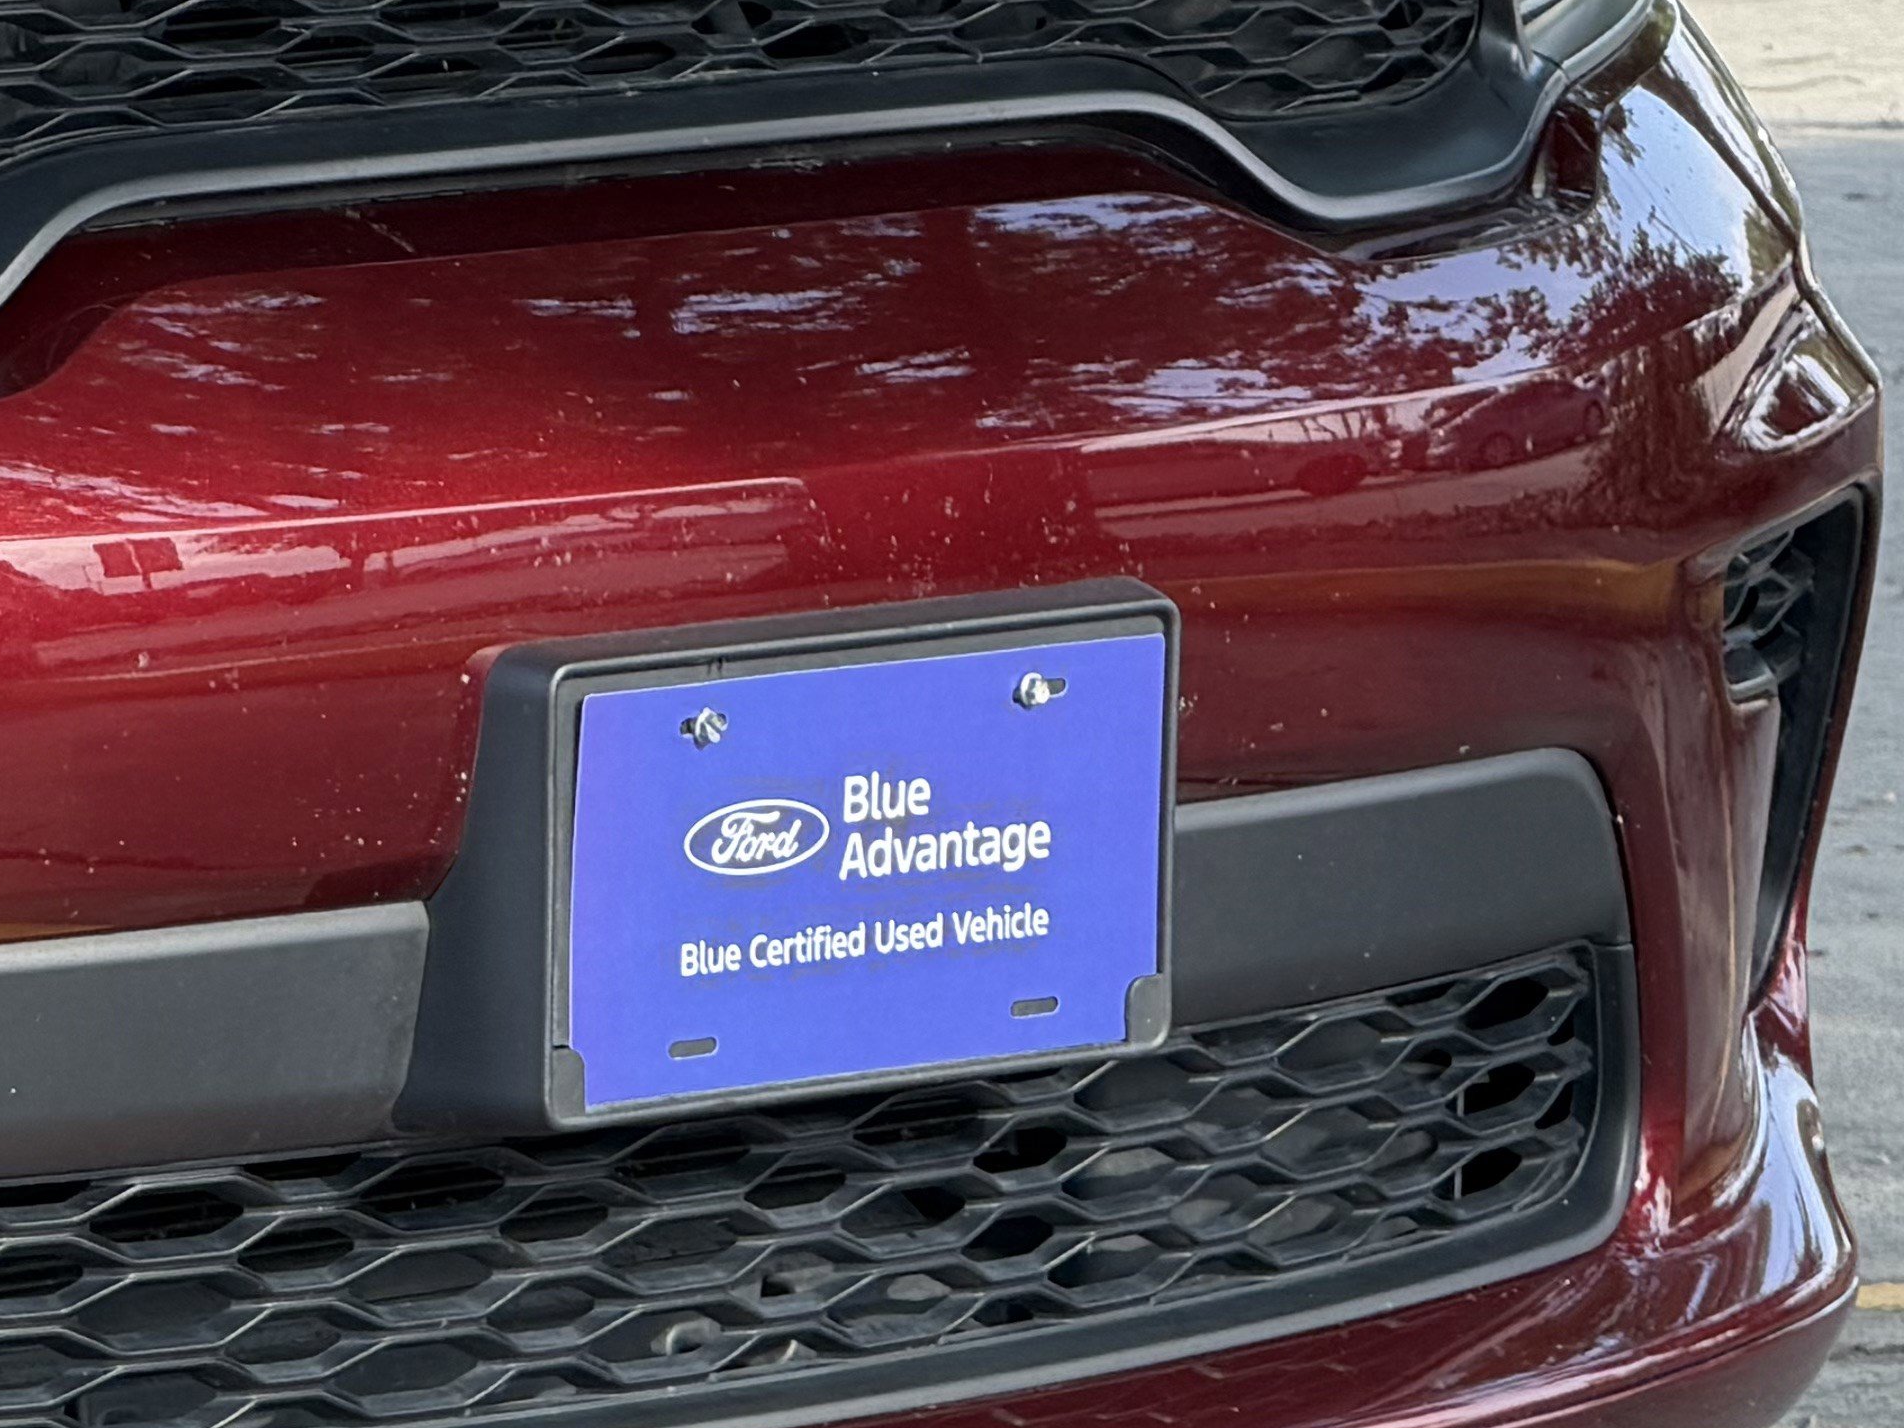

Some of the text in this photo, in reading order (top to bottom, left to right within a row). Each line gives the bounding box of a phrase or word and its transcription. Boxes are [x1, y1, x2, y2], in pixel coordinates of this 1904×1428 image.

[841, 771, 931, 824] Blue
[710, 810, 801, 866] Ford
[839, 815, 1052, 881] Advantage
[680, 903, 1050, 977] Blue Certified Used Vehicle
